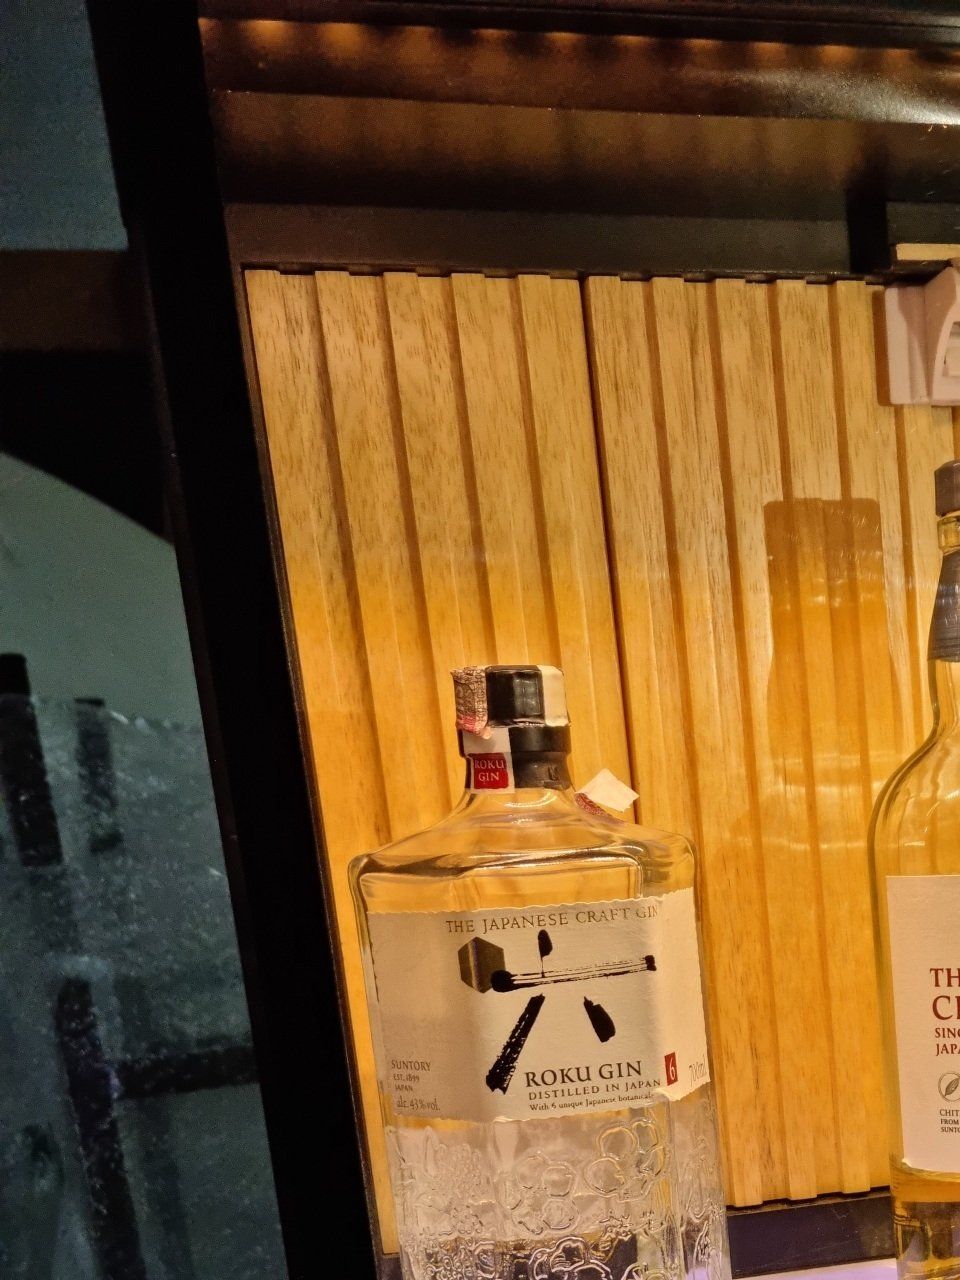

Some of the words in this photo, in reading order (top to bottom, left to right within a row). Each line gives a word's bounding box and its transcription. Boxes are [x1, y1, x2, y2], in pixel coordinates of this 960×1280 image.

[473, 759, 505, 770] ROKU
[478, 771, 501, 782] GIN
[446, 919, 475, 934] THE
[482, 913, 569, 934] JAPANESE
[576, 908, 631, 924] CRAFT
[636, 905, 658, 919] GIN
[391, 1059, 431, 1072] SUNTORY
[524, 1066, 592, 1088] ROKU
[599, 1060, 643, 1080] GIN
[529, 1085, 599, 1101] DISTILLED
[606, 1083, 620, 1093] IN
[625, 1079, 661, 1092] JAPAN
[530, 1102, 549, 1112] With
[558, 1099, 583, 1109] unique
[585, 1096, 616, 1108] Japanese
[940, 1118, 960, 1126] FROM
